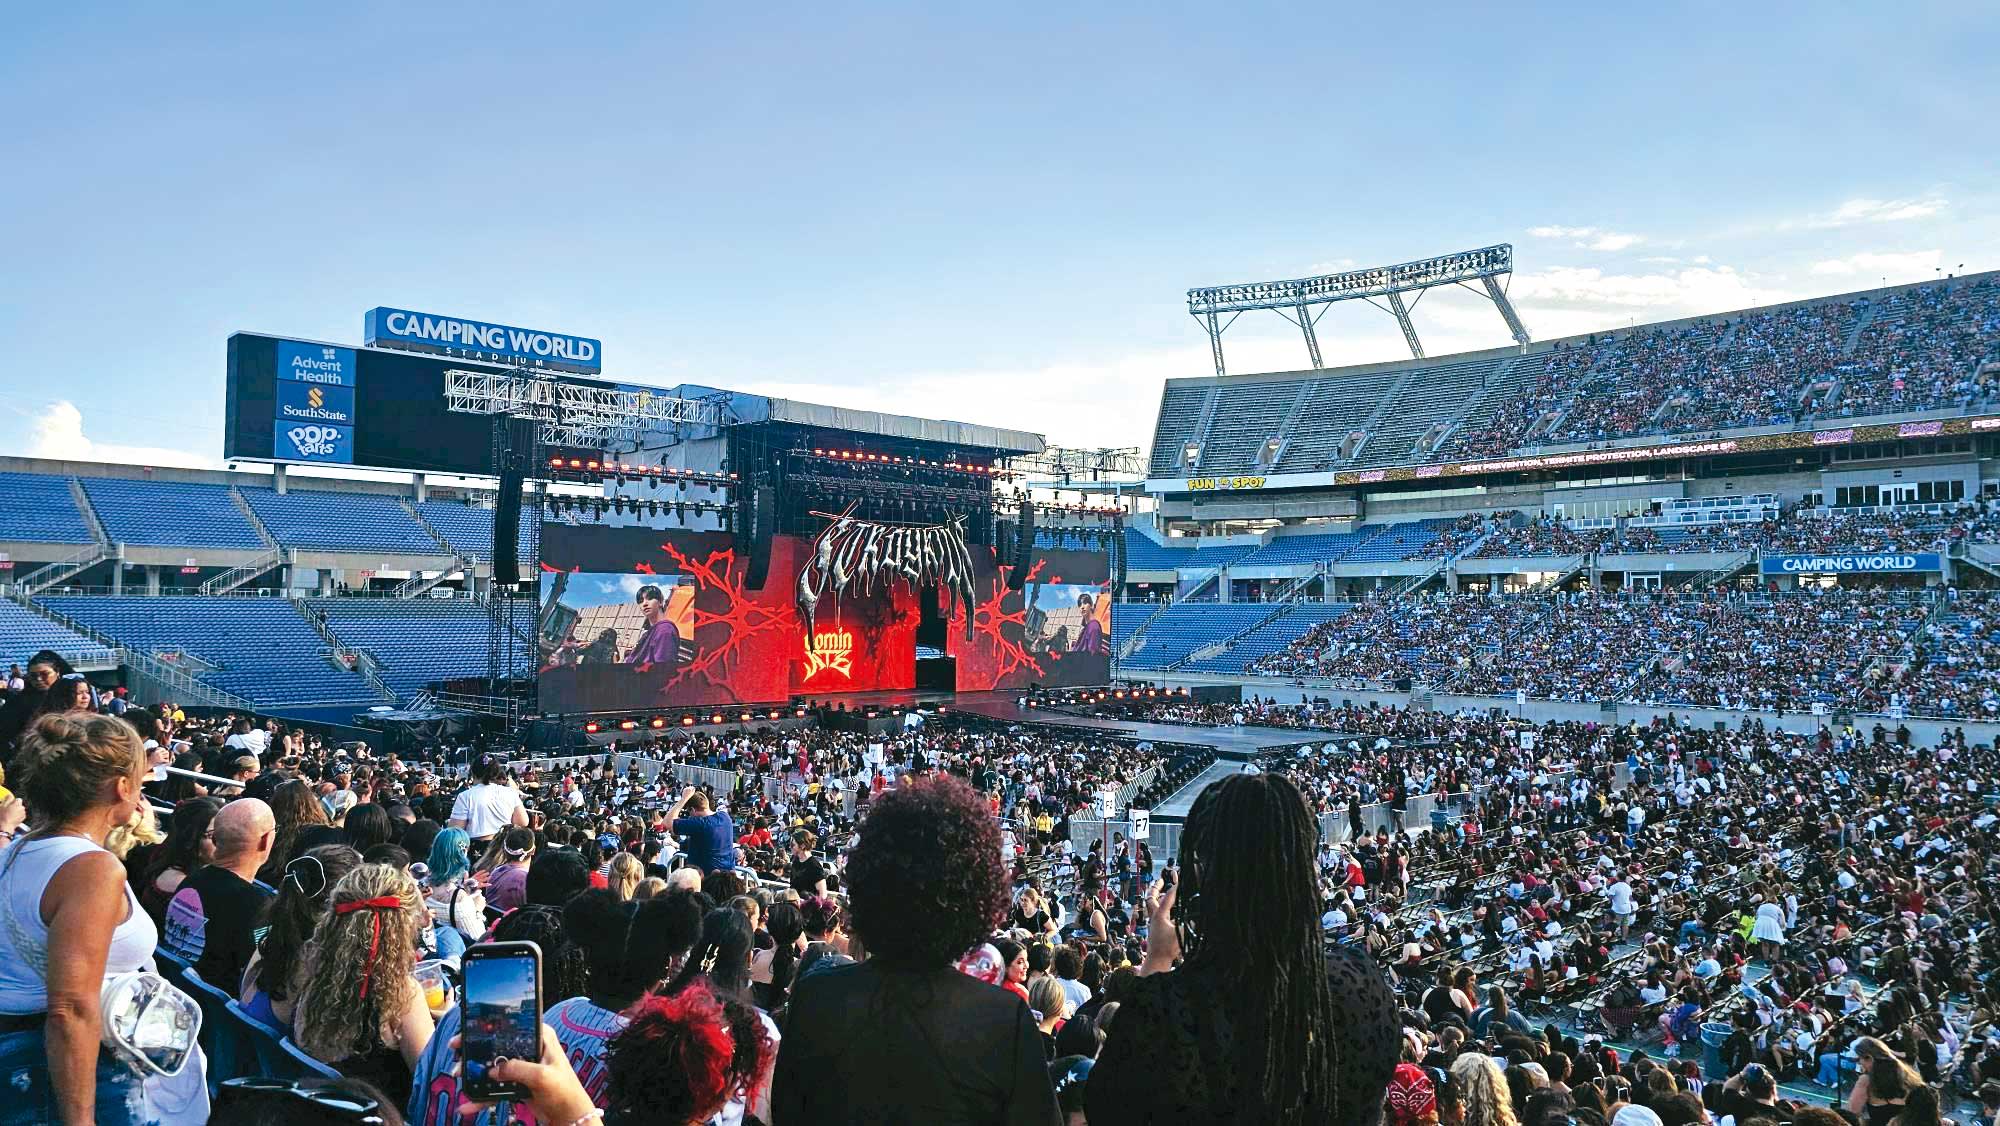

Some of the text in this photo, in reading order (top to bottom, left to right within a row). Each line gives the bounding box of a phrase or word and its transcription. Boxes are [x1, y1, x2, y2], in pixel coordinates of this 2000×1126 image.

[386, 312, 595, 361] CAMPING WORLD
[292, 356, 342, 371] Advent
[445, 347, 543, 367] STADIUM
[295, 369, 342, 384] Health
[283, 405, 346, 420] SouthState
[1543, 455, 1585, 464] TERMITE
[1586, 450, 1652, 461] PROTECTION,
[1654, 444, 1719, 456] LANDSCAPE
[1188, 477, 1266, 490] FUN SPOT
[1782, 556, 1916, 571] CAMPING WORLD
[1136, 818, 1148, 832] F7
